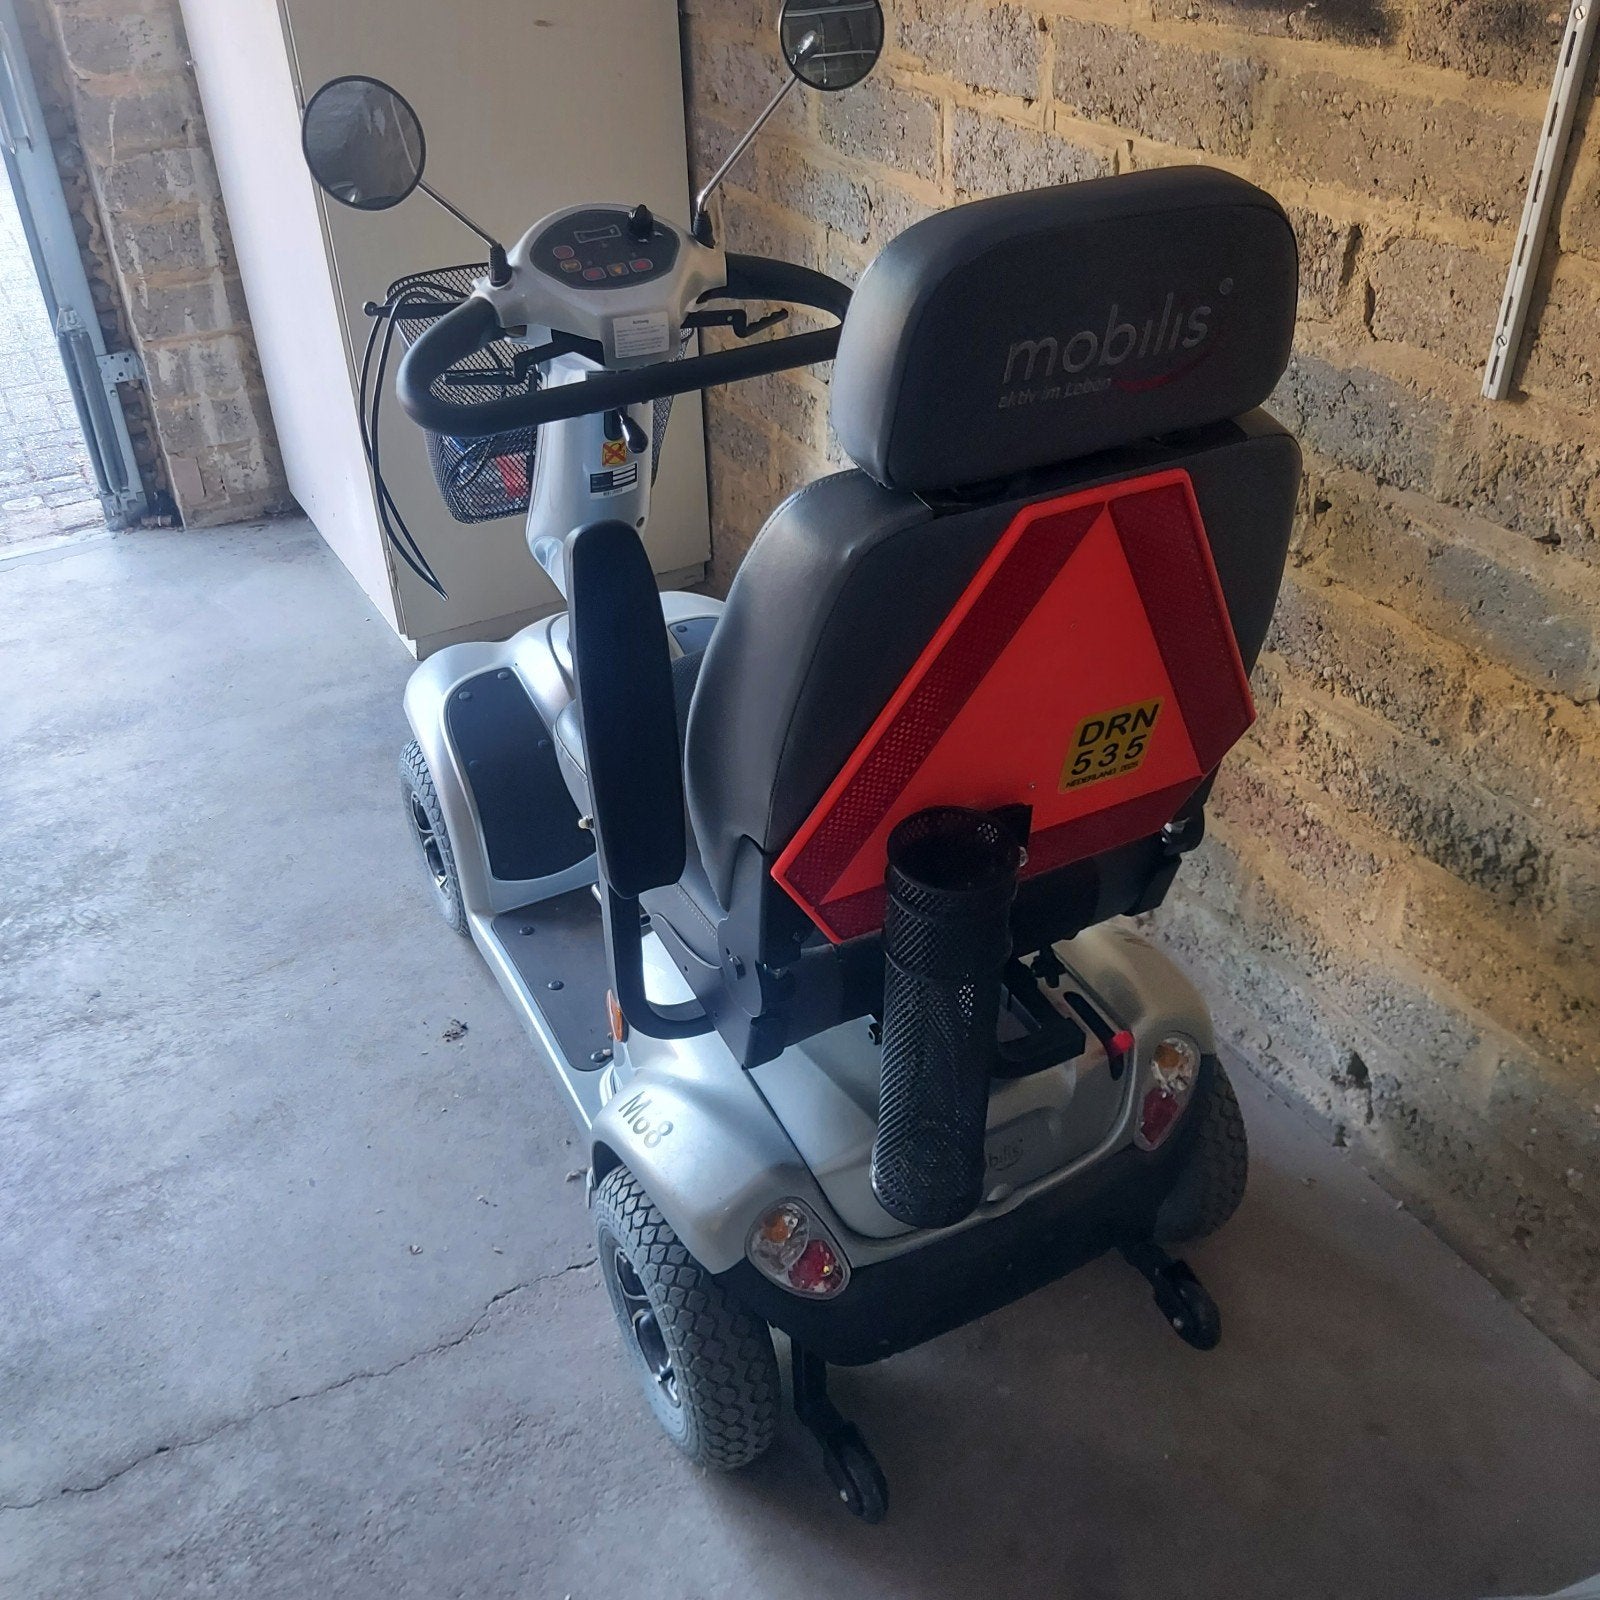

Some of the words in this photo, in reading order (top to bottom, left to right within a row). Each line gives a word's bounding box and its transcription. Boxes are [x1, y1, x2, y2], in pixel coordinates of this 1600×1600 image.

[1003, 292, 1212, 385] mobilis
[1078, 703, 1159, 748] DRN
[1071, 734, 1147, 776] 535
